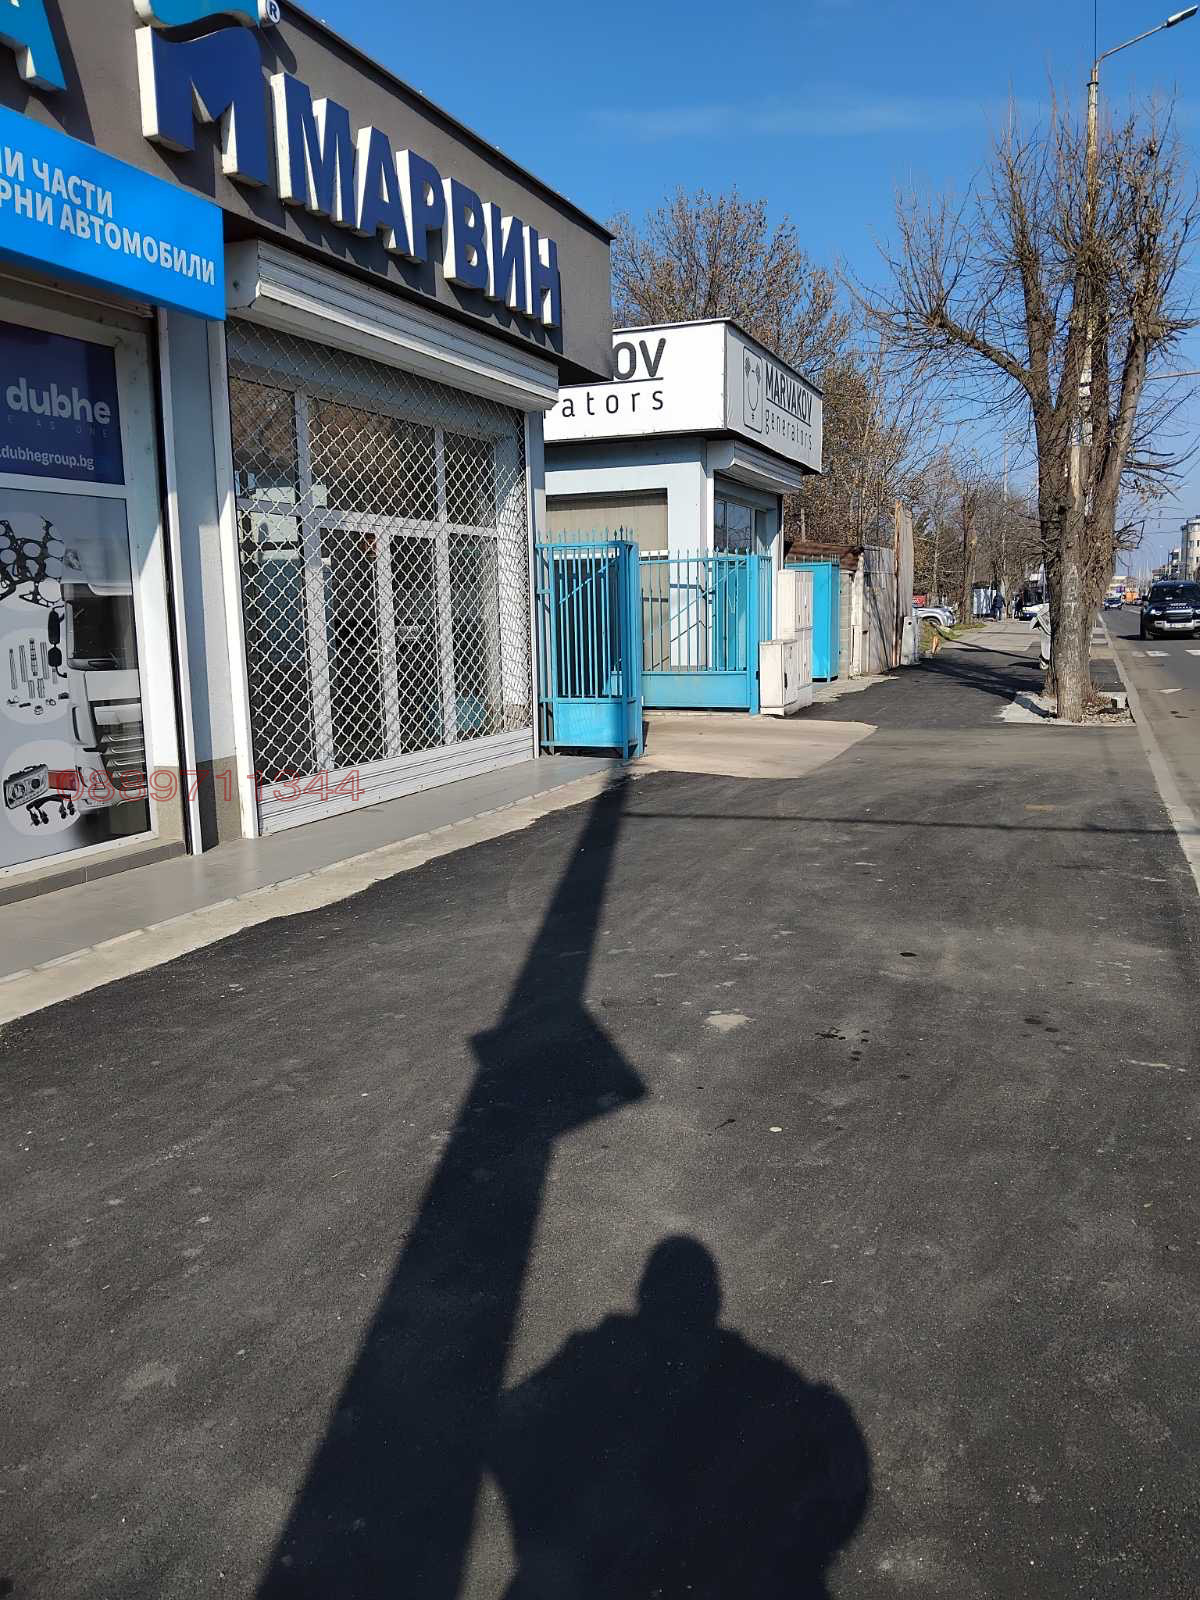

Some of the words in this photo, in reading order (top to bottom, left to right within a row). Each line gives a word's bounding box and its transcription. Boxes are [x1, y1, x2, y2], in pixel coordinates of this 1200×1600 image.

[32, 158, 113, 218] ЧАСТИ
[271, 73, 560, 329] МАРВИН
[59, 203, 215, 286] АВТОМОБИЛИ
[6, 377, 111, 424] dubhe
[765, 362, 812, 424] MARVAKOV
